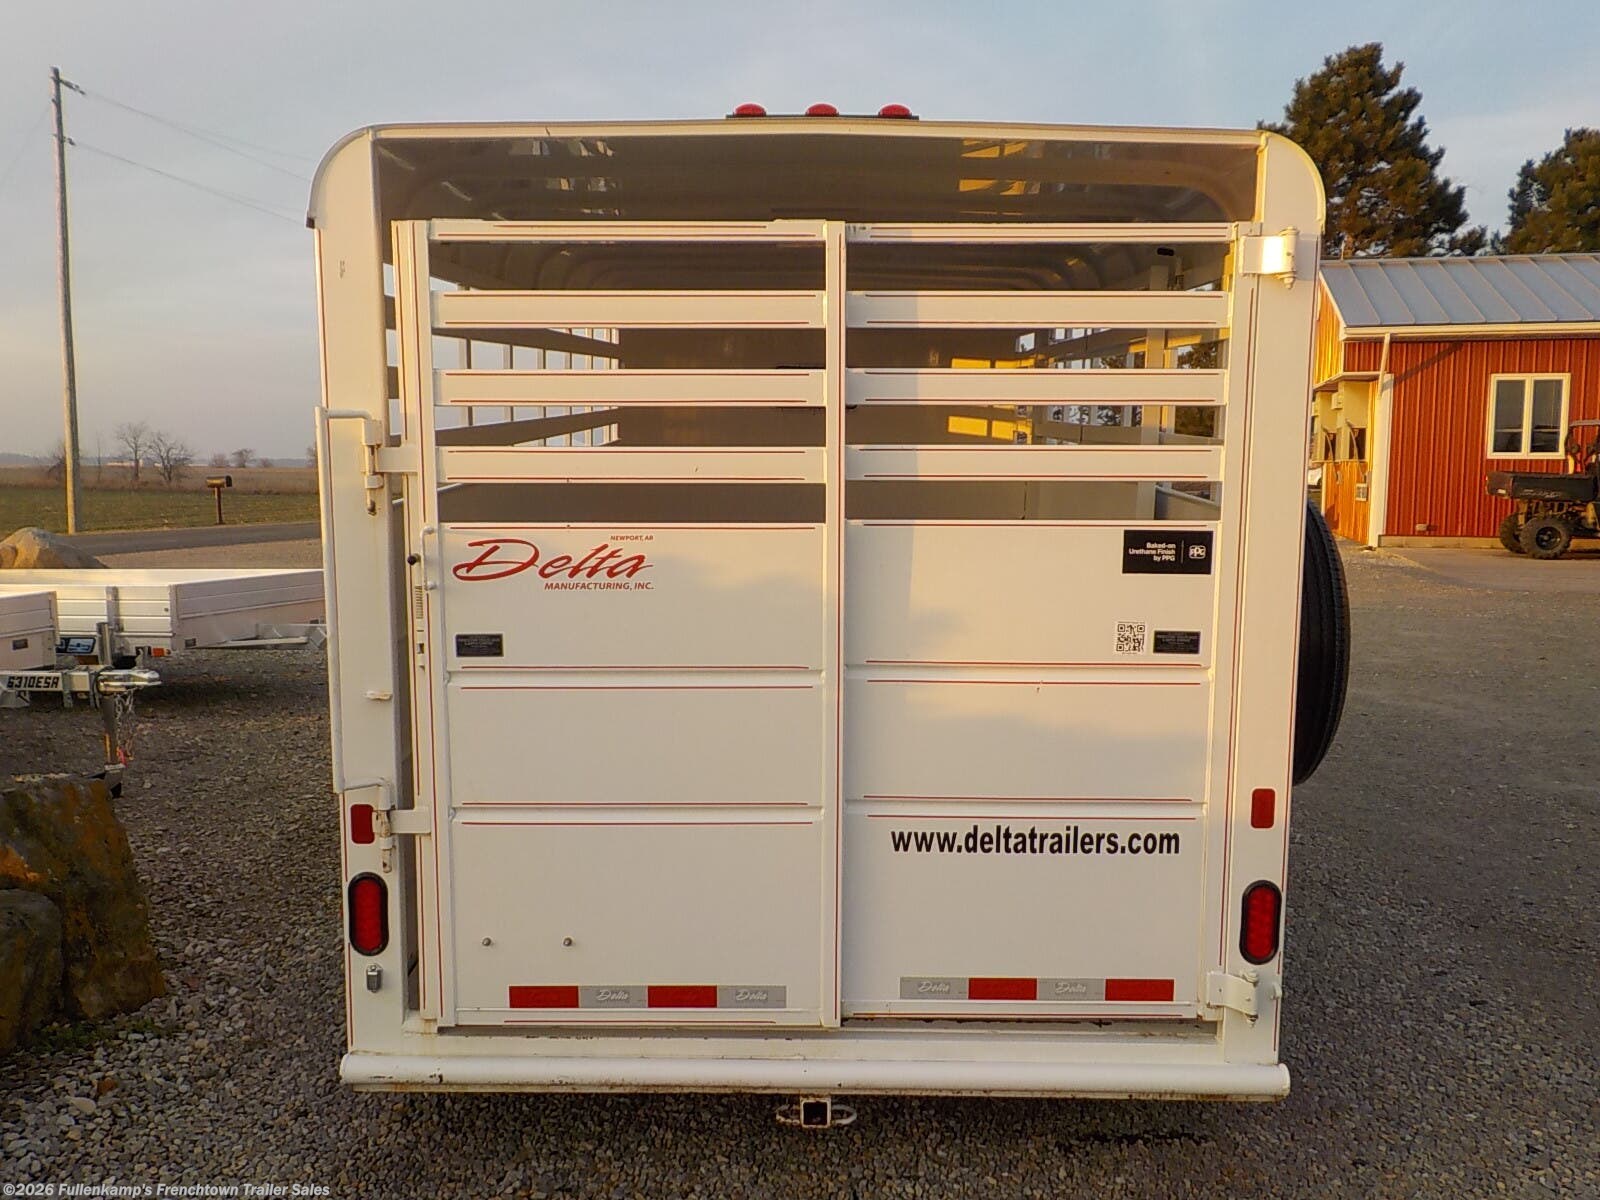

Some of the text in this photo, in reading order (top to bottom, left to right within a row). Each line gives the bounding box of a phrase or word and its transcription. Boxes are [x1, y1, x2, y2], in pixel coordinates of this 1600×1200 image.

[452, 538, 653, 581] Delta
[544, 582, 655, 591] MANUFACTURING, INC.
[891, 824, 1180, 855] www.deltatrailers.com
